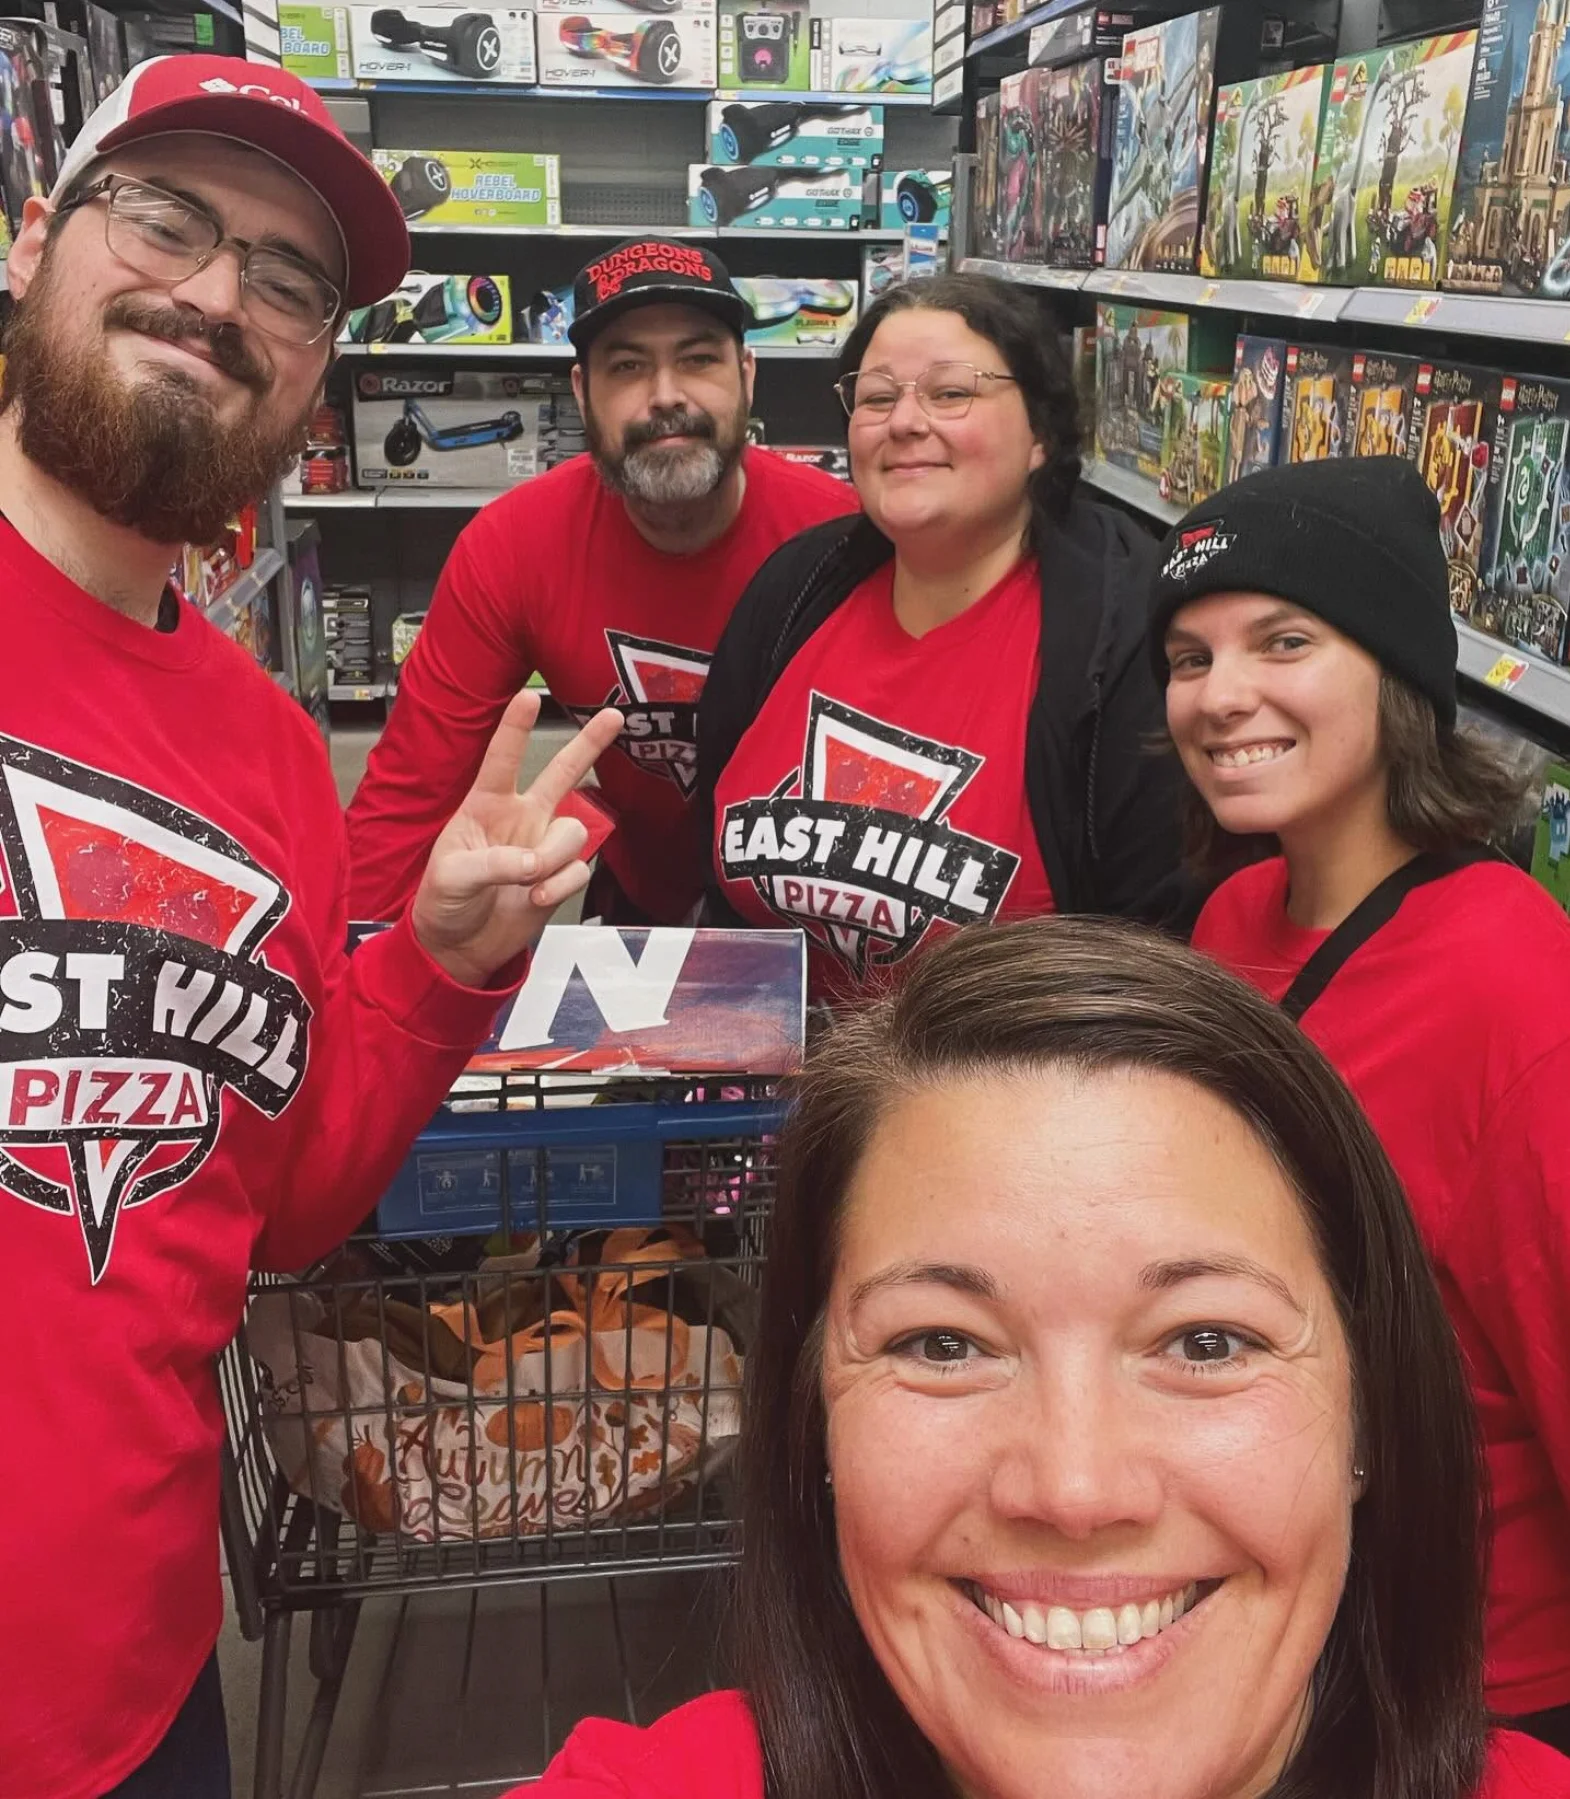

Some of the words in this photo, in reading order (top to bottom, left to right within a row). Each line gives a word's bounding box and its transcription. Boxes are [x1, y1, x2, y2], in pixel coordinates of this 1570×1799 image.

[545, 68, 596, 78] HOVER-1
[452, 188, 541, 201] HOVERBOARD
[586, 243, 703, 285] DUNGEONS
[609, 257, 712, 282] DRAGONS
[382, 377, 451, 393] Razor
[724, 816, 845, 864] EAST
[852, 827, 989, 915] HILL
[784, 880, 898, 935] PIZZA
[152, 960, 300, 1091] HILL
[8, 1068, 203, 1126] PIZZA
